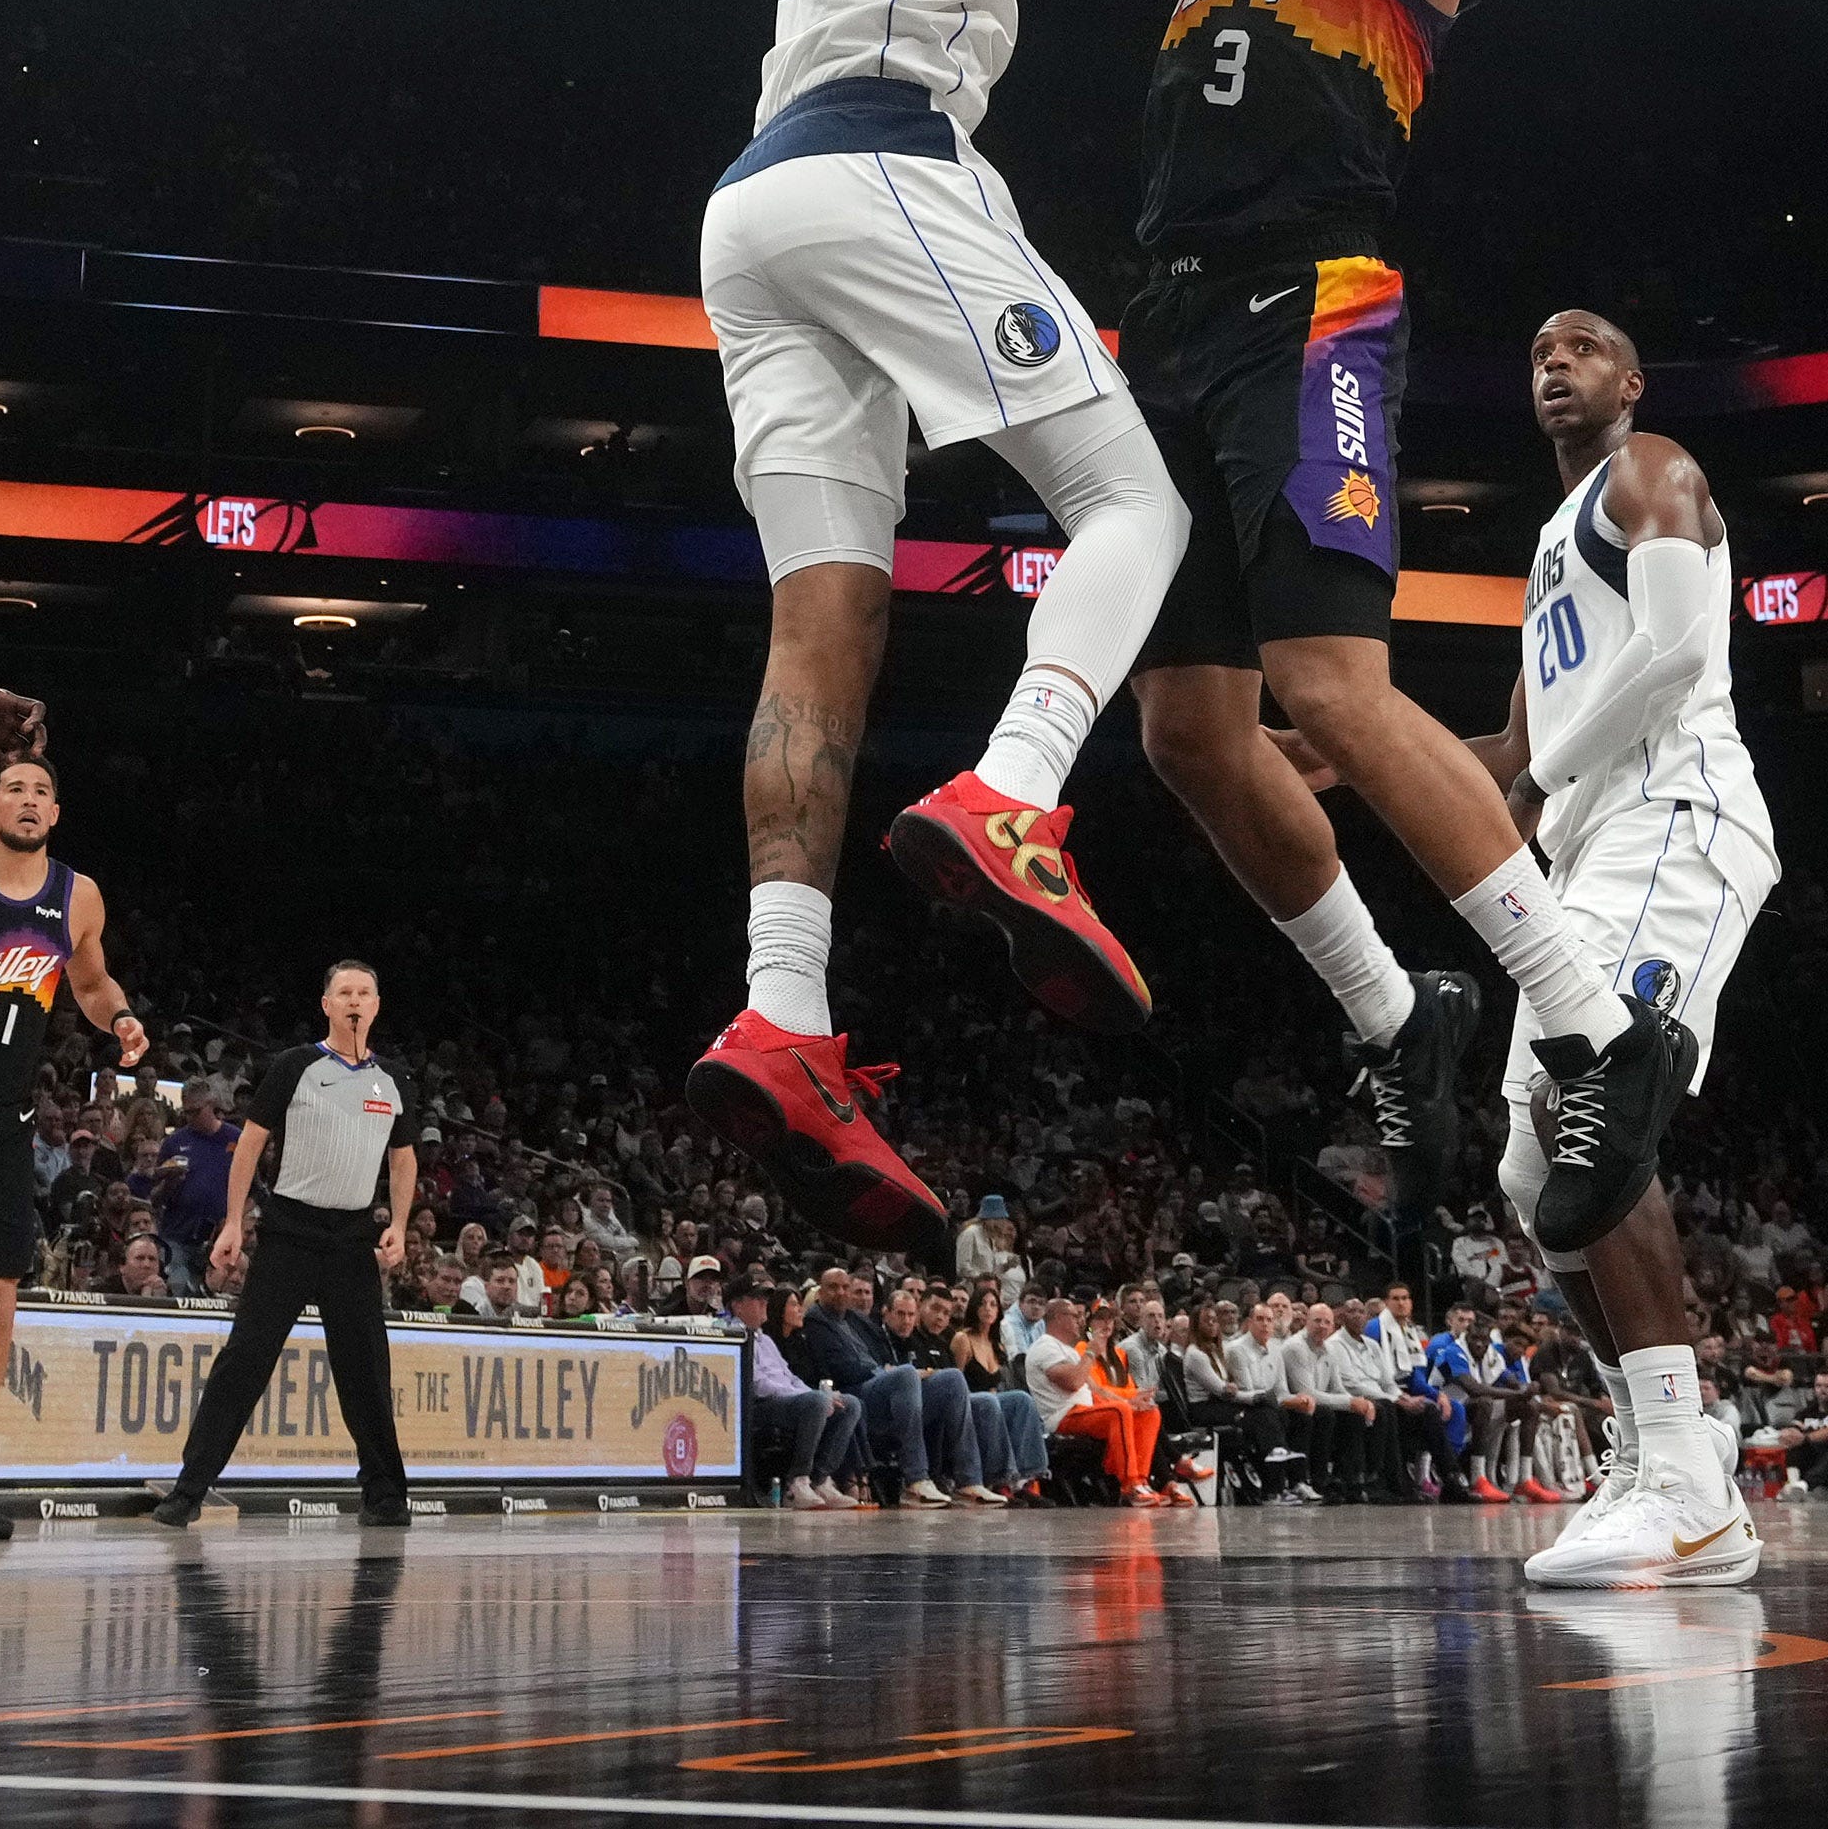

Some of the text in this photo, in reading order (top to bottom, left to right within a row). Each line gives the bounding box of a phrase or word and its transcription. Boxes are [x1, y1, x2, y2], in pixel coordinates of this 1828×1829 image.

[1203, 29, 1251, 106] 3
[1331, 363, 1369, 466] SUNS
[207, 500, 257, 546] LETS
[1753, 579, 1798, 621] LETS
[1537, 593, 1586, 692] 20
[35, 905, 62, 919] PayPal
[1, 1003, 19, 1045] 1
[63, 1291, 107, 1305] FANDUEL
[414, 1312, 449, 1323] FANDUEL
[605, 1321, 637, 1332] FANDUEL
[414, 1346, 730, 1440] THE VALLEY JIM BEAM
[412, 1501, 447, 1514] FANDUEL
[514, 1498, 548, 1512] FANDUEL
[609, 1495, 640, 1508] FANDUEL
[697, 1494, 727, 1507] FANDUEL
[55, 1503, 99, 1518] FANDUEL
[301, 1503, 340, 1516] FANDUEL
